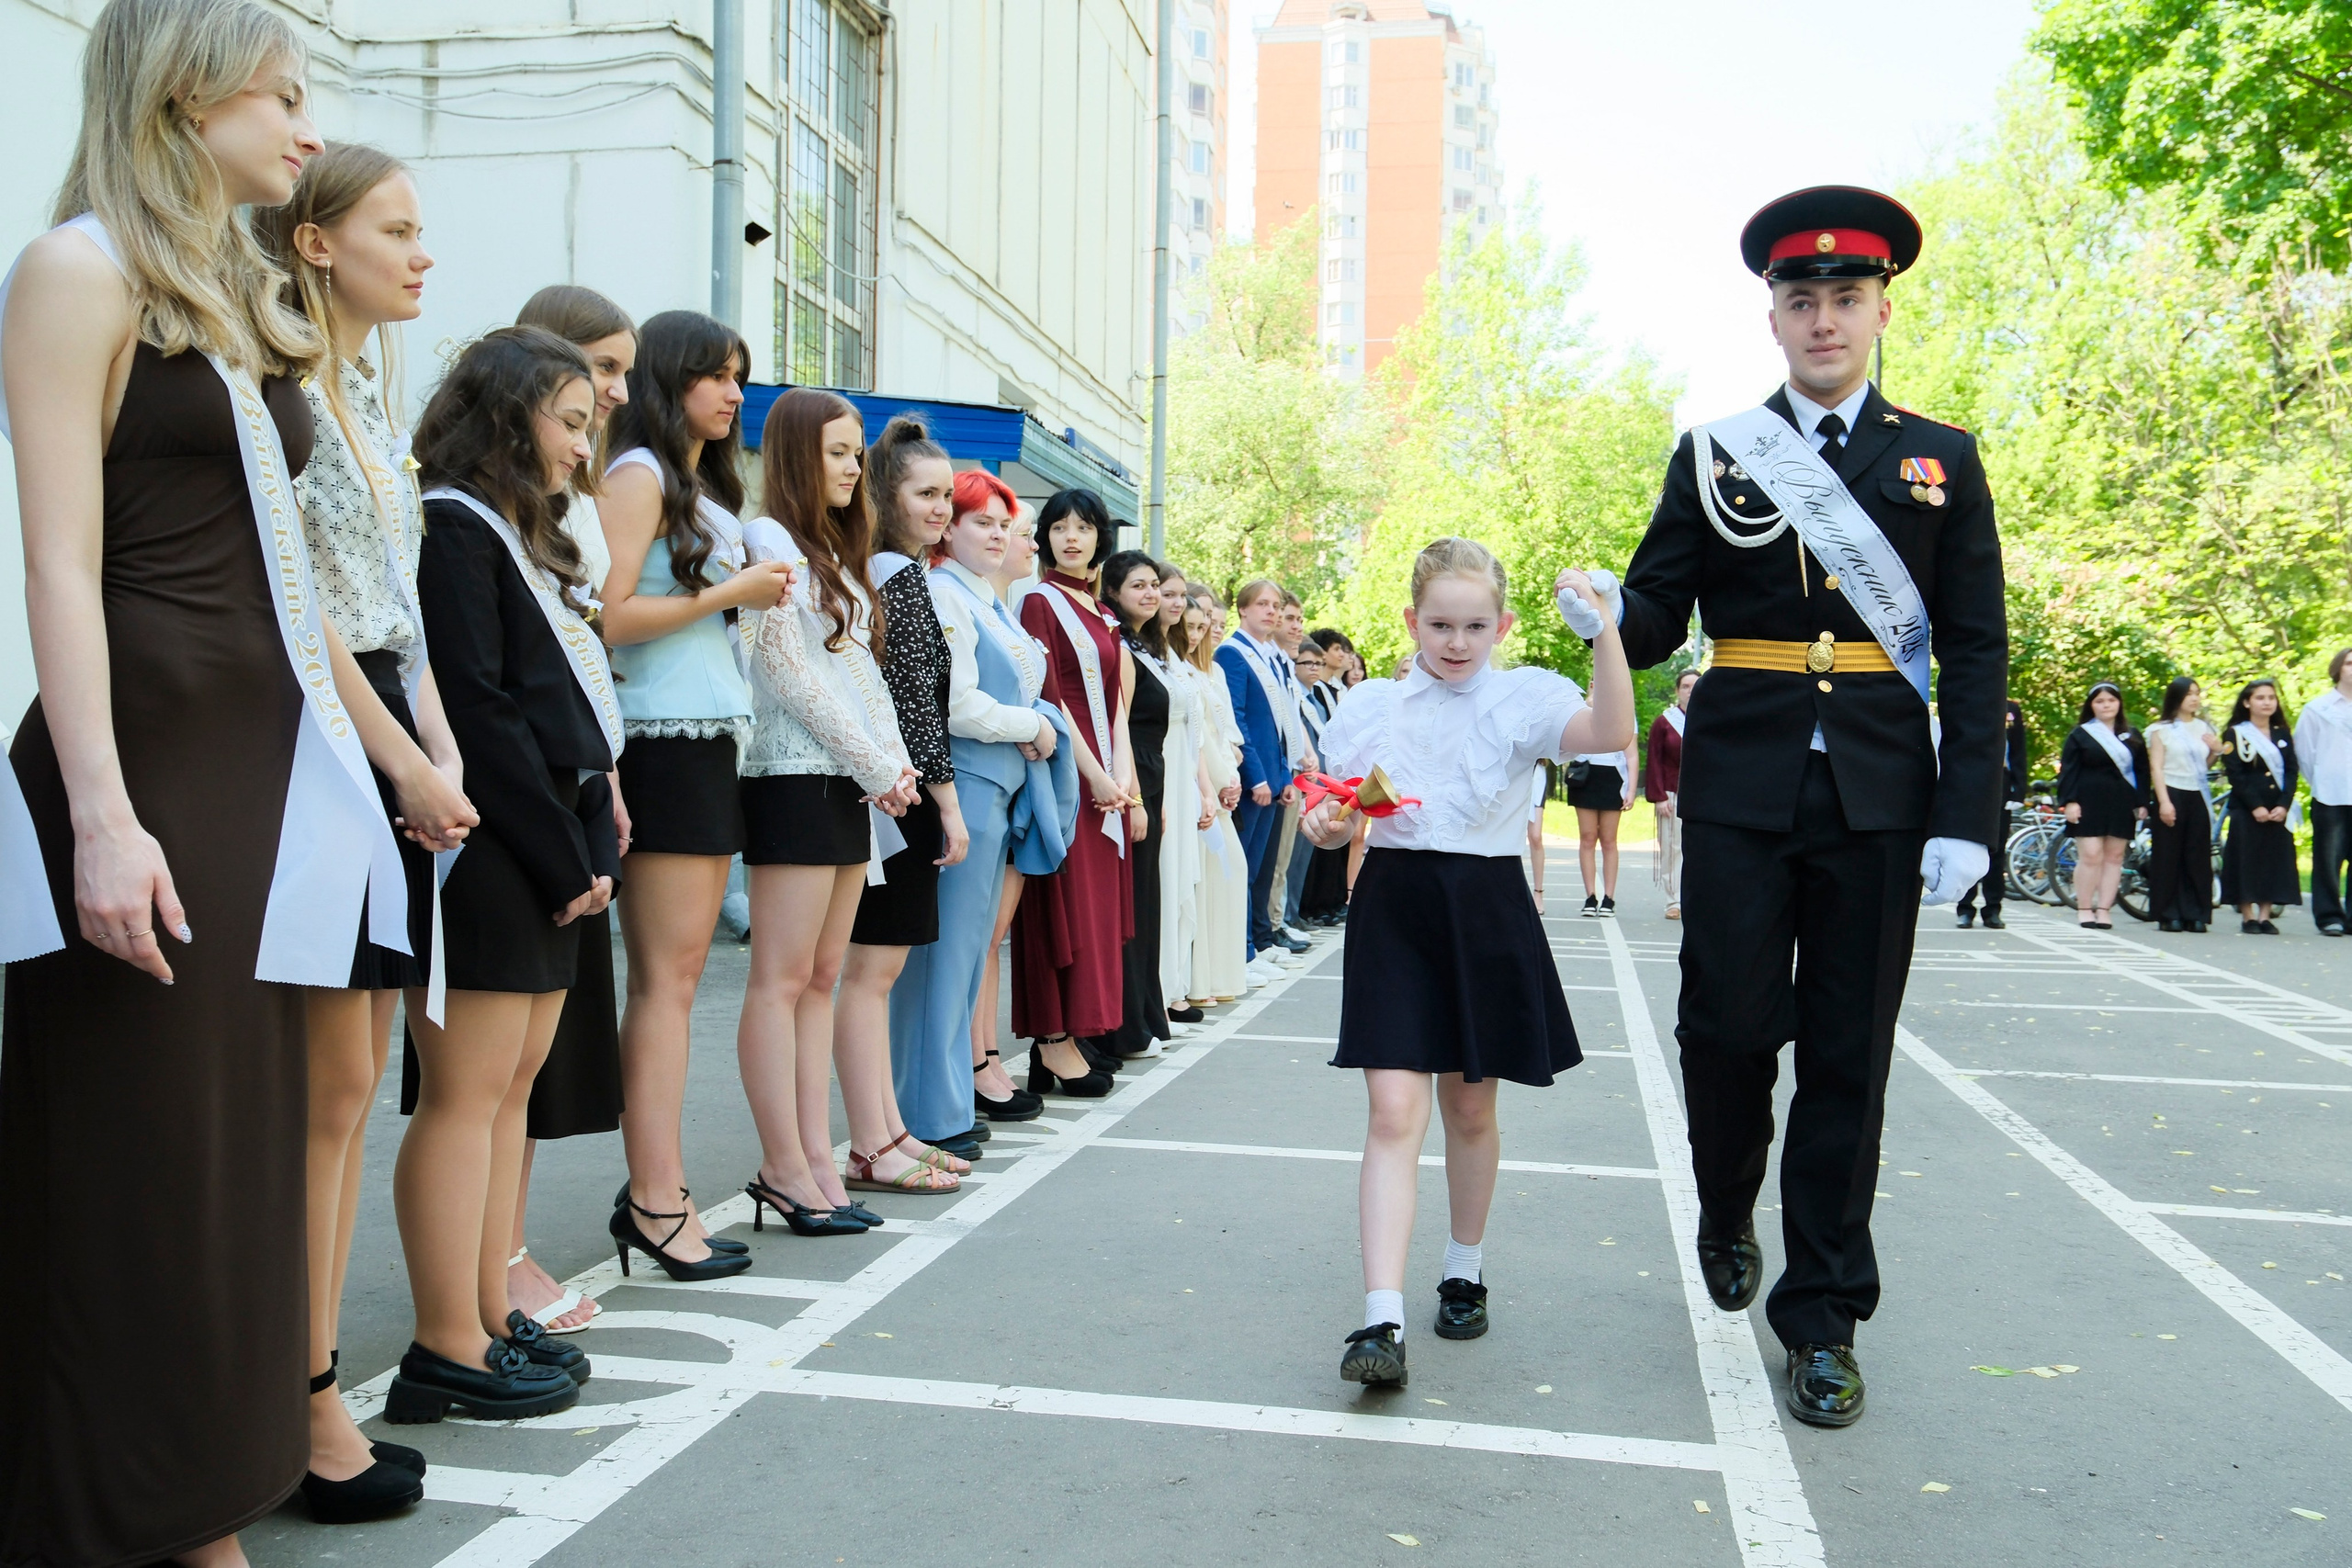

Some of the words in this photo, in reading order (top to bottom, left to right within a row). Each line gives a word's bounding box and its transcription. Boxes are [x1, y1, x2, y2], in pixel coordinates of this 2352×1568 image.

[1770, 459, 1904, 618] Выпускник
[1888, 615, 1926, 664] 2026
[292, 631, 352, 740] 2026
